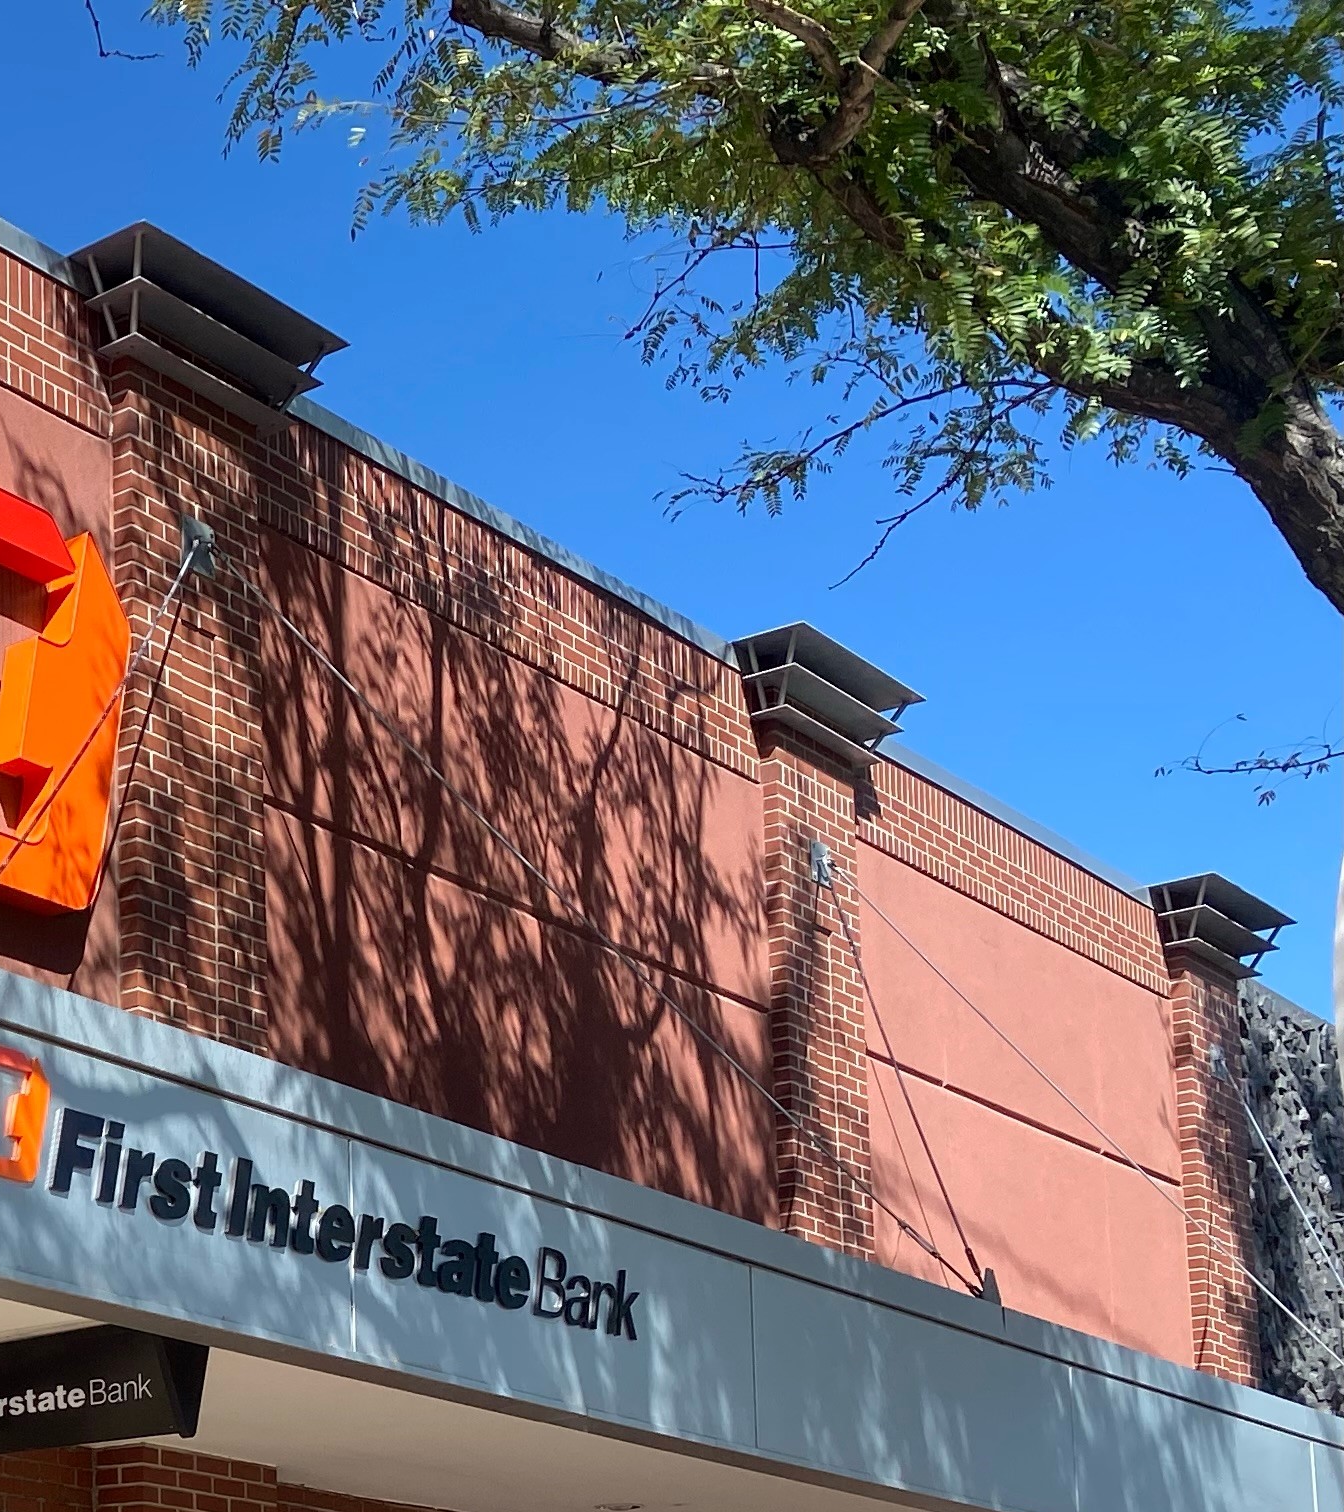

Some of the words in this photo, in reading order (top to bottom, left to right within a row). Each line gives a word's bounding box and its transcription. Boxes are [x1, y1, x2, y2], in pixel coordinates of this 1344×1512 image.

[48, 1106, 222, 1230] First
[224, 1157, 531, 1310] Interstate
[534, 1246, 641, 1341] Bank
[89, 1373, 153, 1406] Bank
